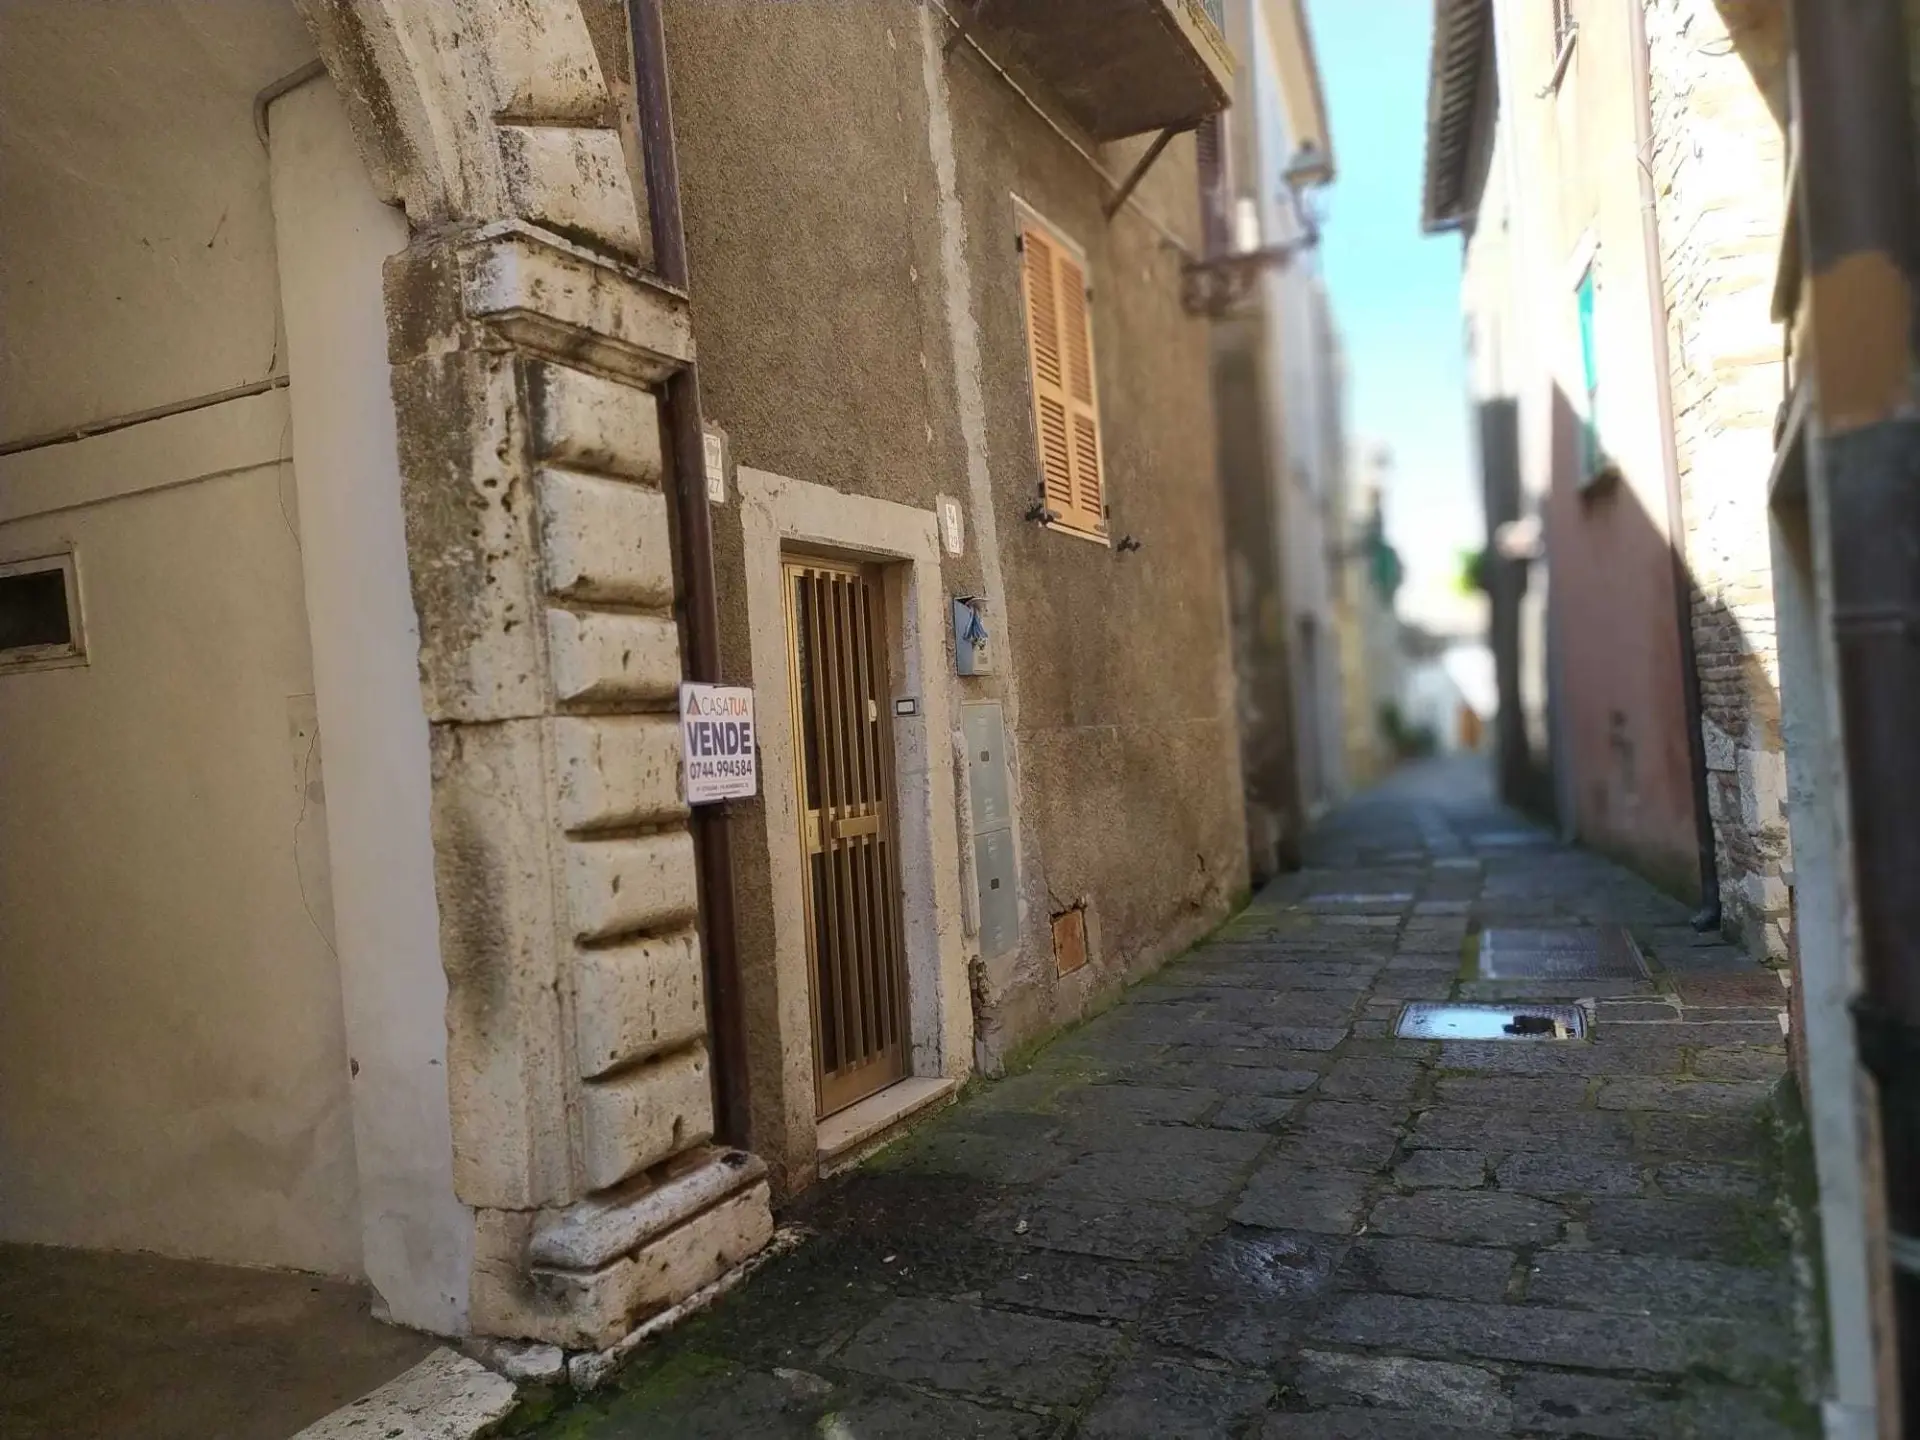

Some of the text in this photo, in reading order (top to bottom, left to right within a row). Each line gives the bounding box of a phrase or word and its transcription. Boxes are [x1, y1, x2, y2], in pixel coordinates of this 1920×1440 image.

[701, 696, 748, 716] CASATUA
[687, 722, 752, 756] VENDE
[689, 759, 752, 779] 0744.994584
